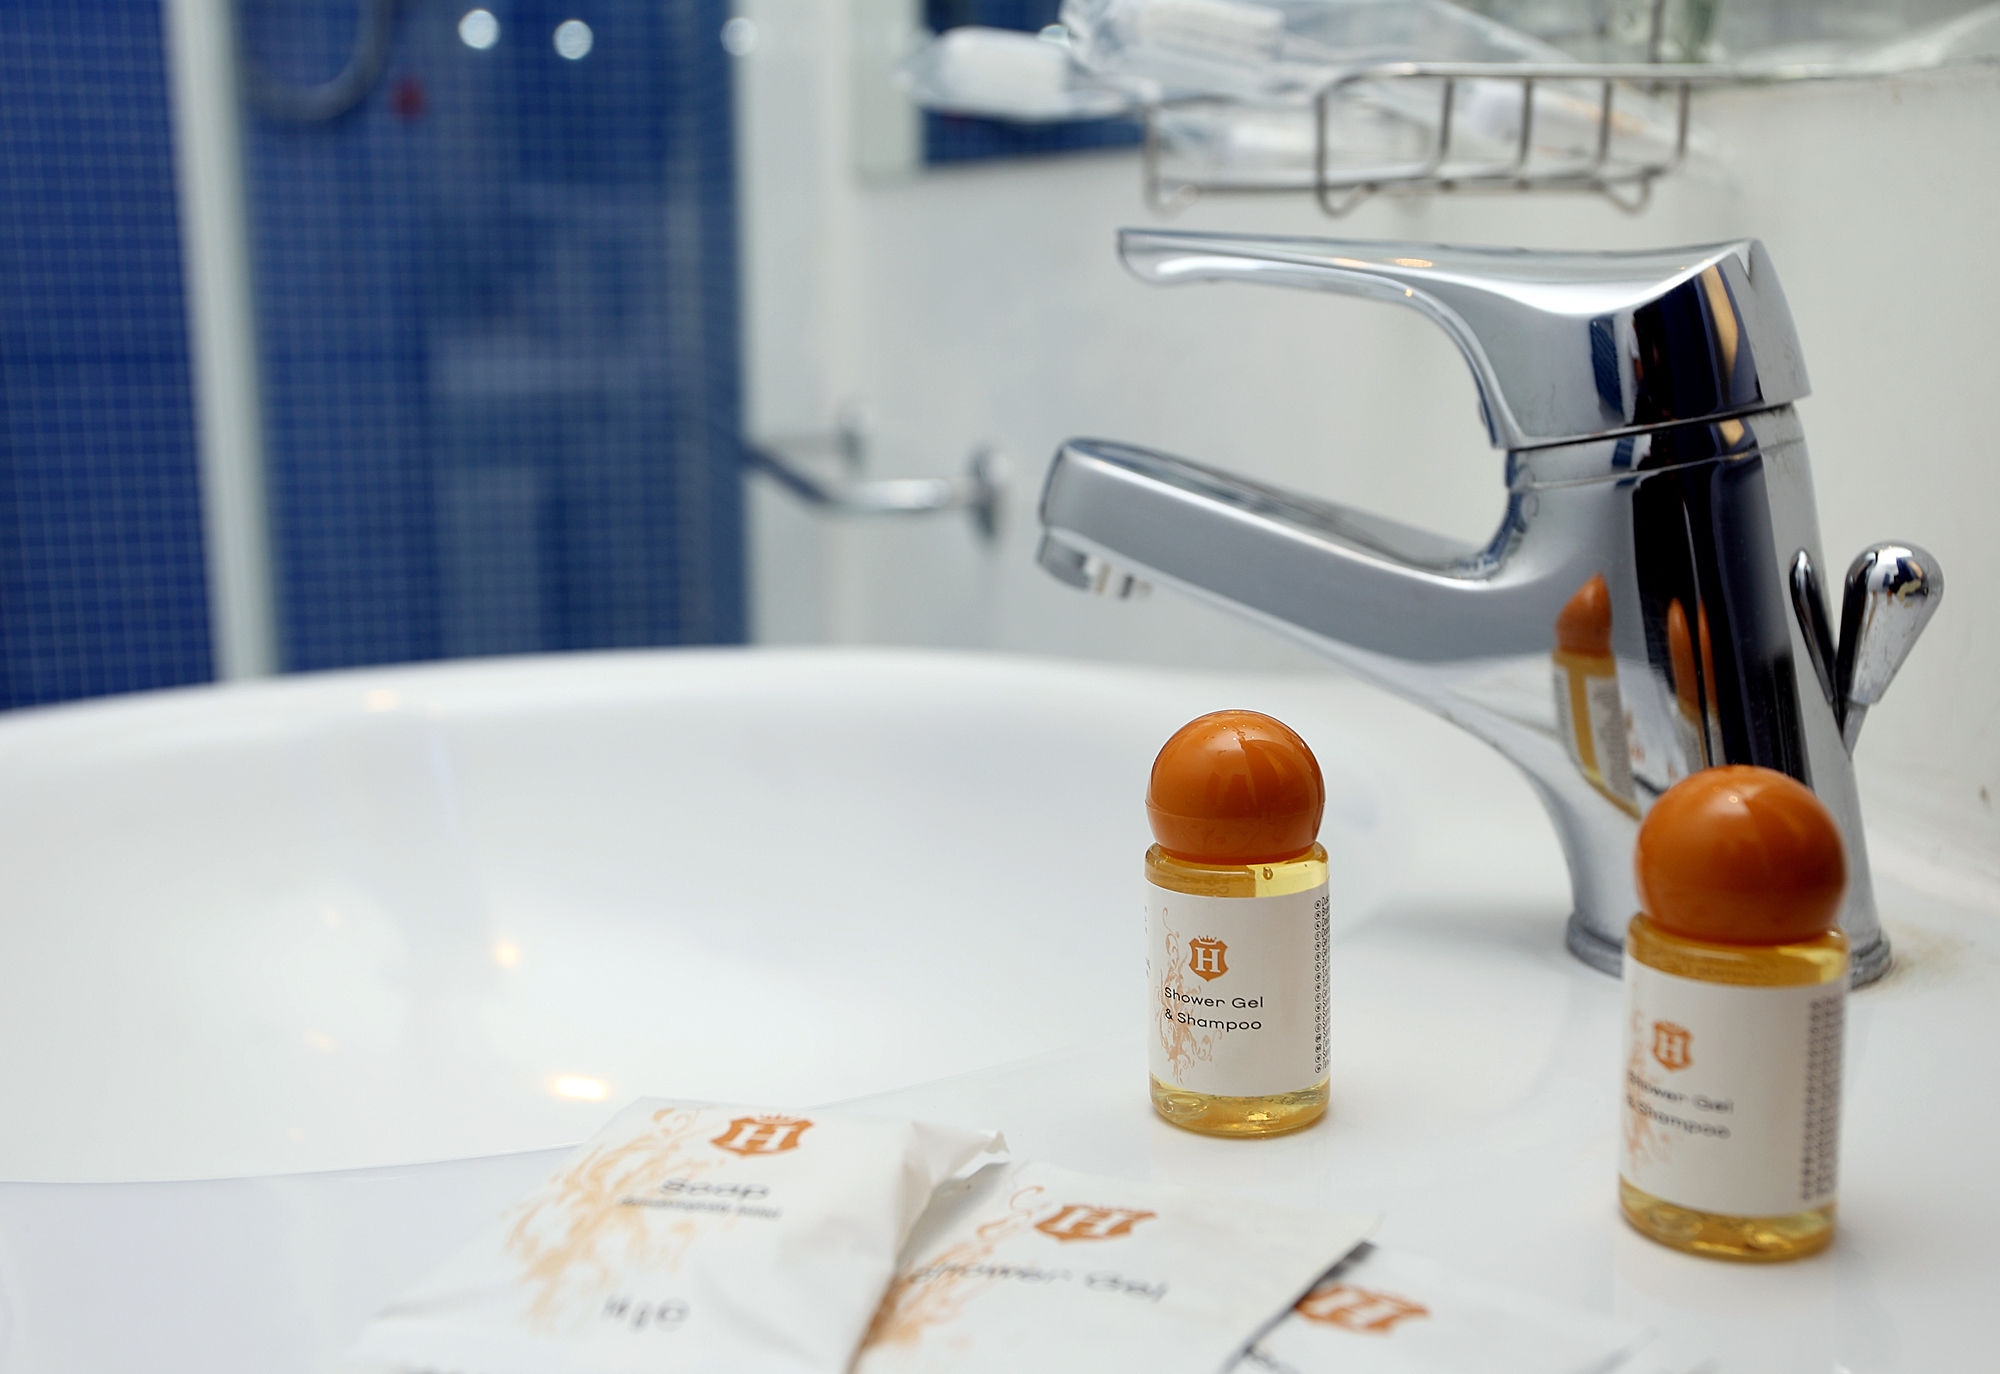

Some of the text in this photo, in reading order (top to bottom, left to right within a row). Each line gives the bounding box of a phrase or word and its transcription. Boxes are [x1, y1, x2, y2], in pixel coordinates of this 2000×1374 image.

[1164, 986, 1264, 1009] Shower Gel
[1164, 1008, 1262, 1032] & Shampoo
[1692, 1094, 1735, 1114] Gel
[1637, 1101, 1731, 1139] Shampoo
[661, 1178, 770, 1200] Soap
